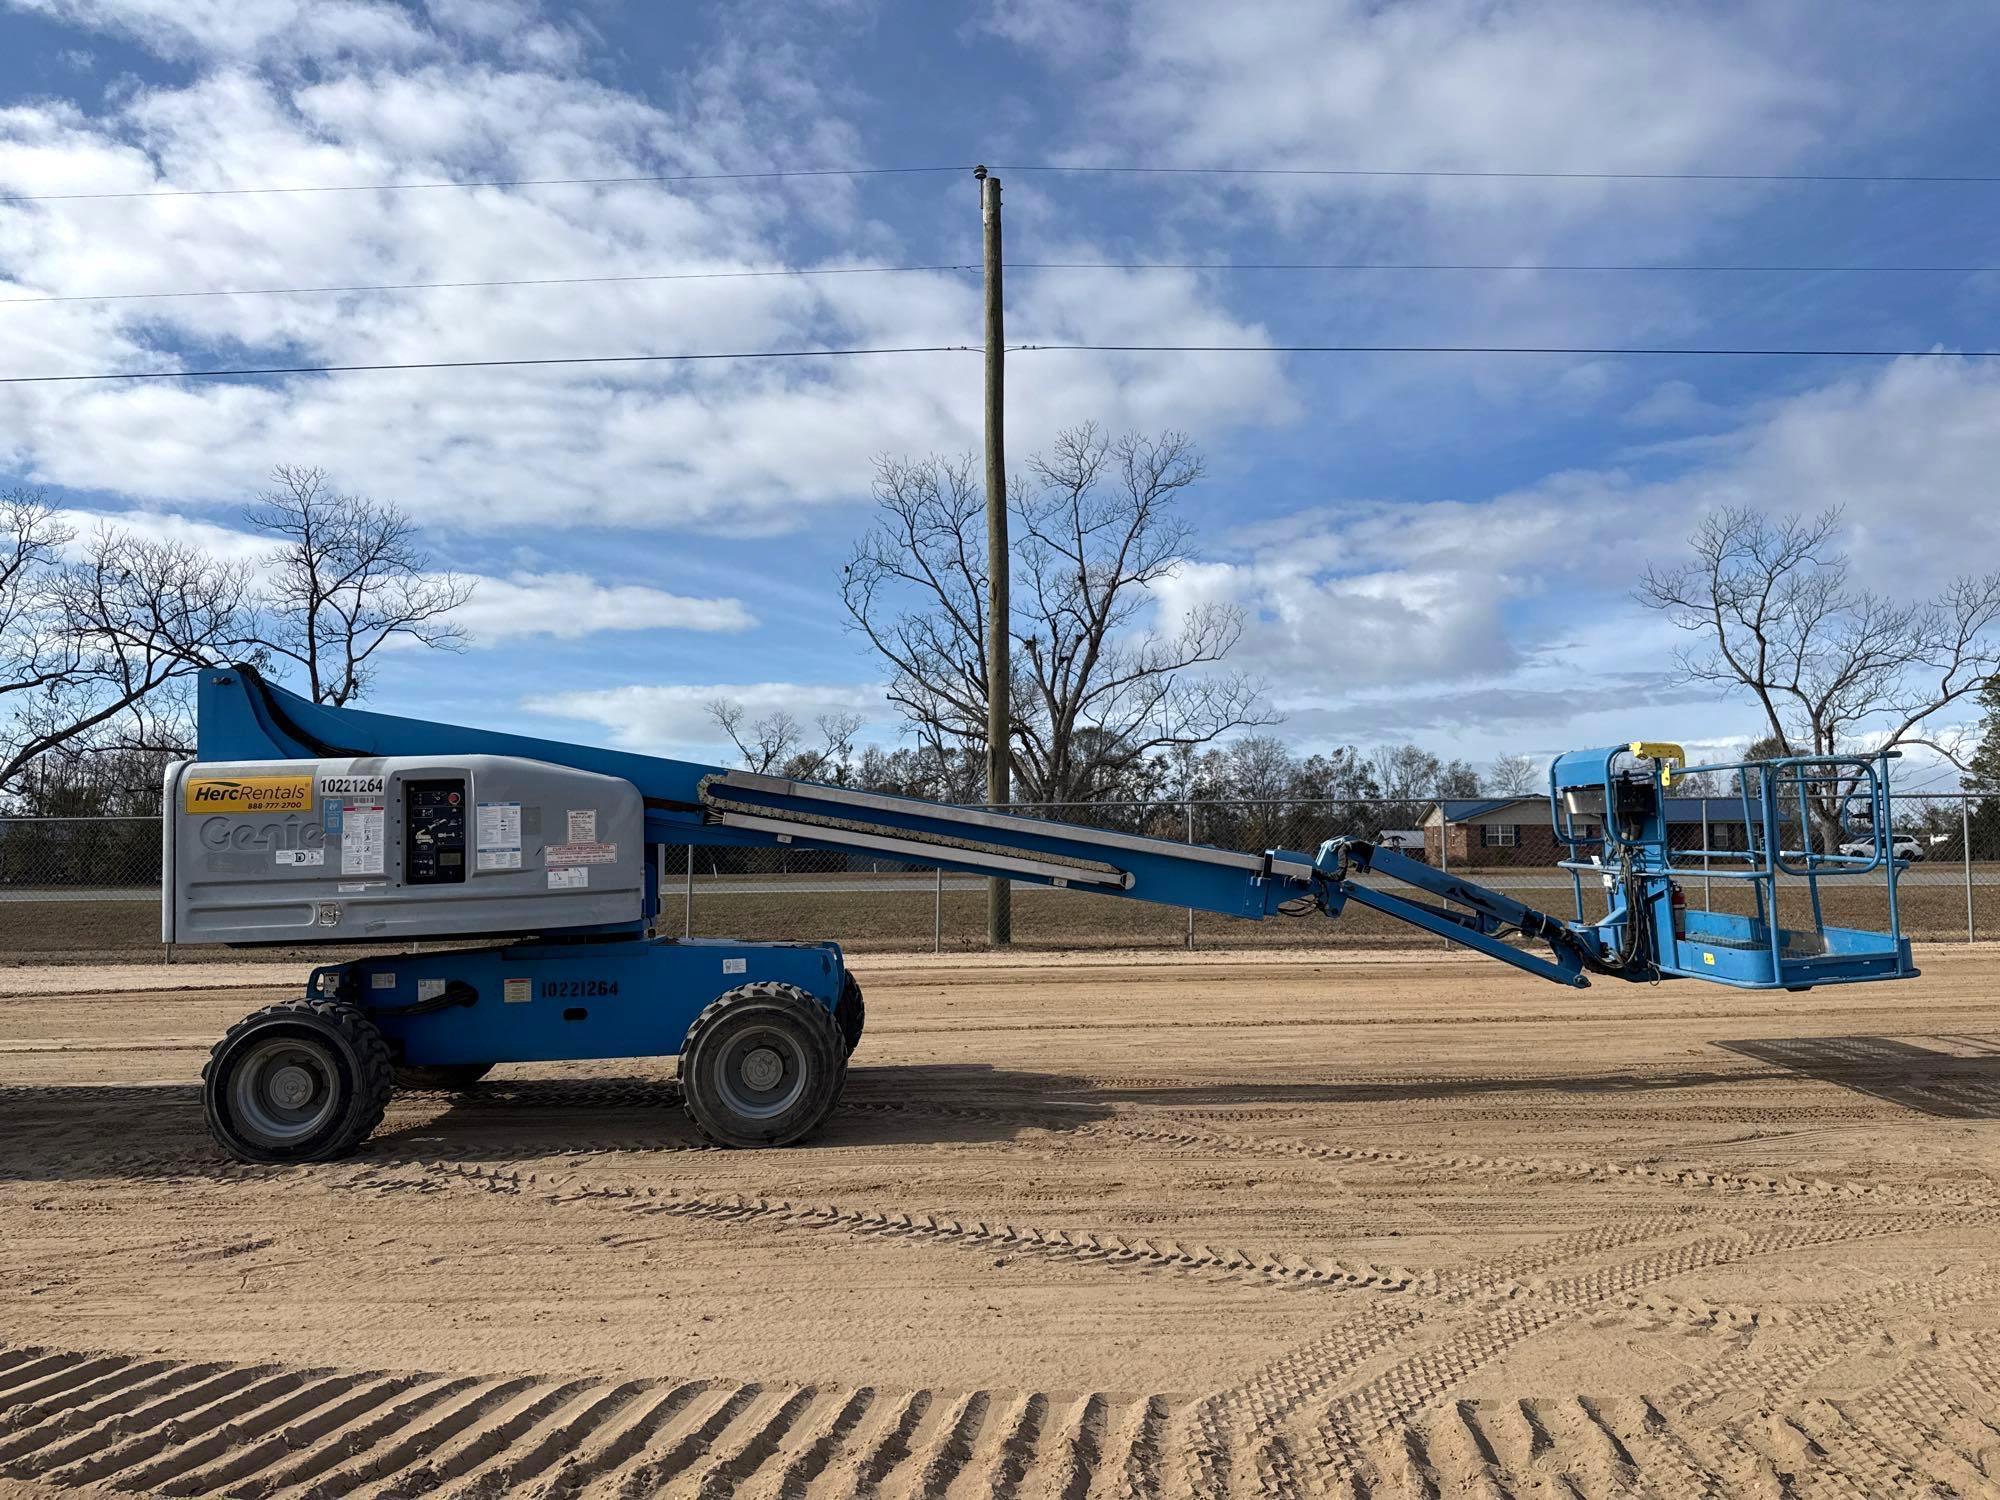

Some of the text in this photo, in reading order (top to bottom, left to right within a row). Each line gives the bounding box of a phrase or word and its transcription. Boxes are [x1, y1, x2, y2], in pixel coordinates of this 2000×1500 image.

[195, 784, 305, 801] HercRentals
[321, 779, 383, 793] 10221264
[542, 981, 618, 998] 10221264
